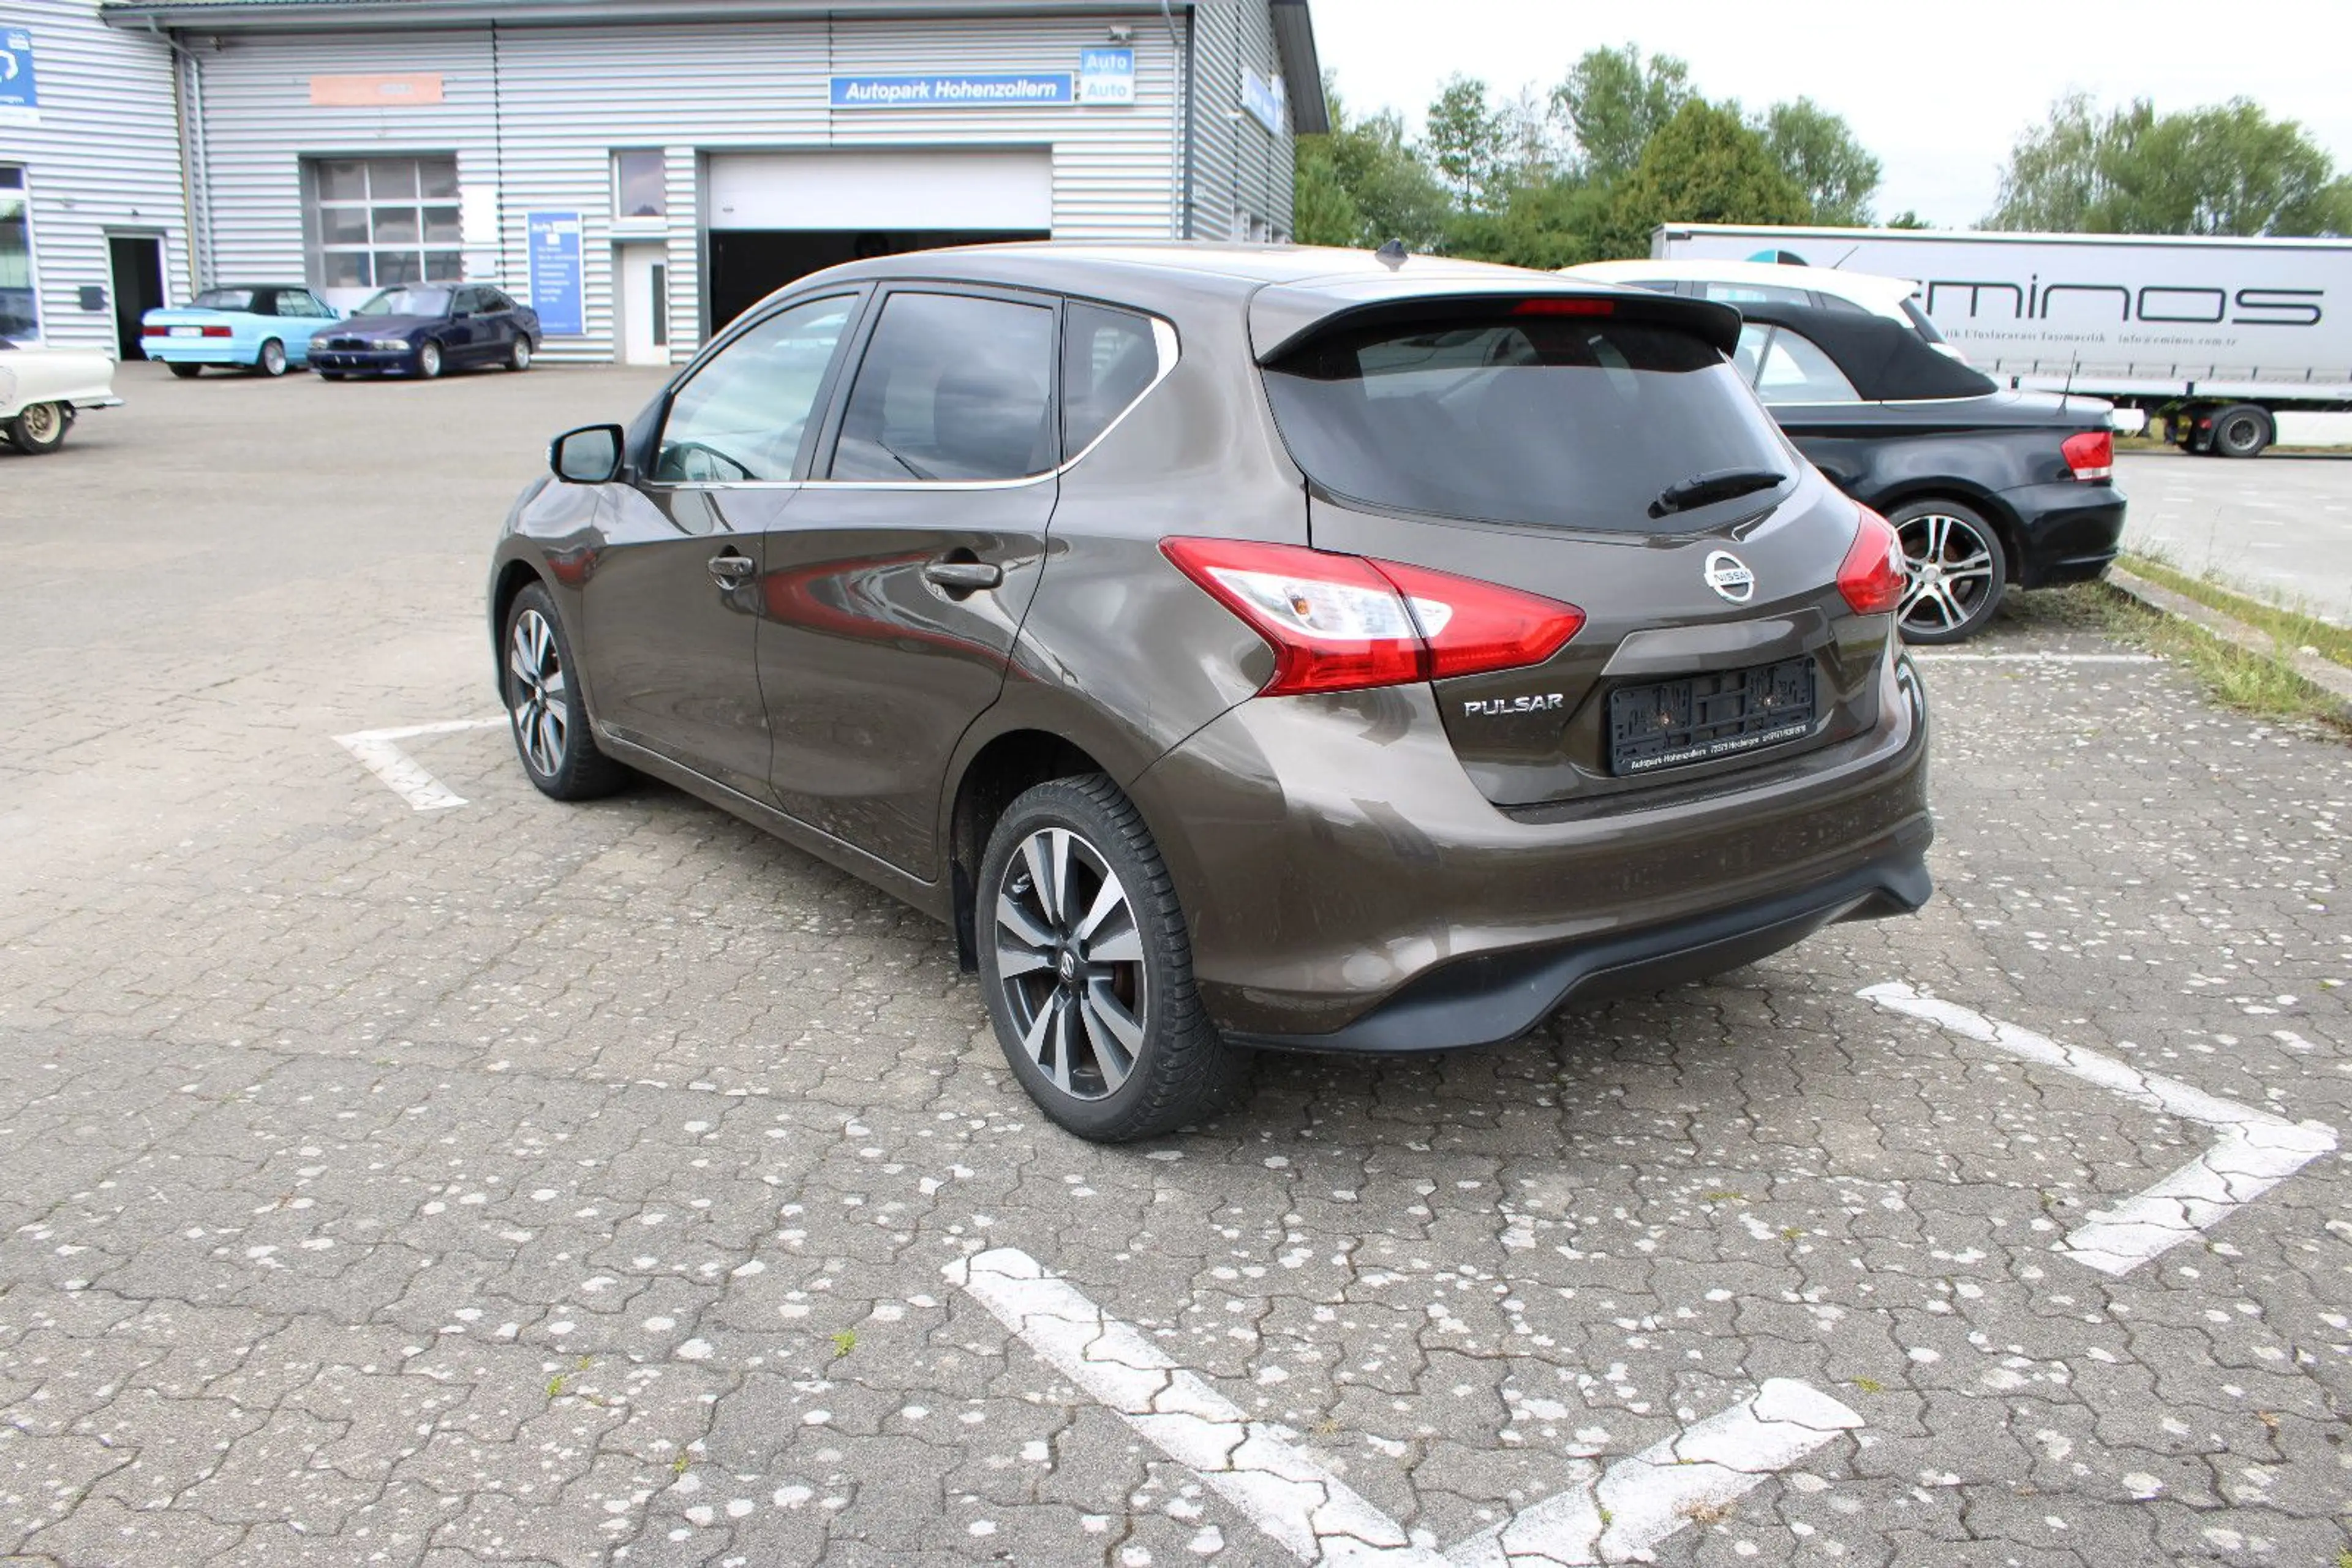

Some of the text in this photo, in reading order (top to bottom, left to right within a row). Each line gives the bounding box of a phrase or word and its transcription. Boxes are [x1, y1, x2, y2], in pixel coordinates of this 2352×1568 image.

[1087, 54, 1128, 71] Auto
[846, 78, 1057, 103] Autopark Hohenzollern
[1087, 83, 1128, 97] Auto
[1911, 273, 2324, 326] minos
[1464, 693, 1564, 717] PULSAR
